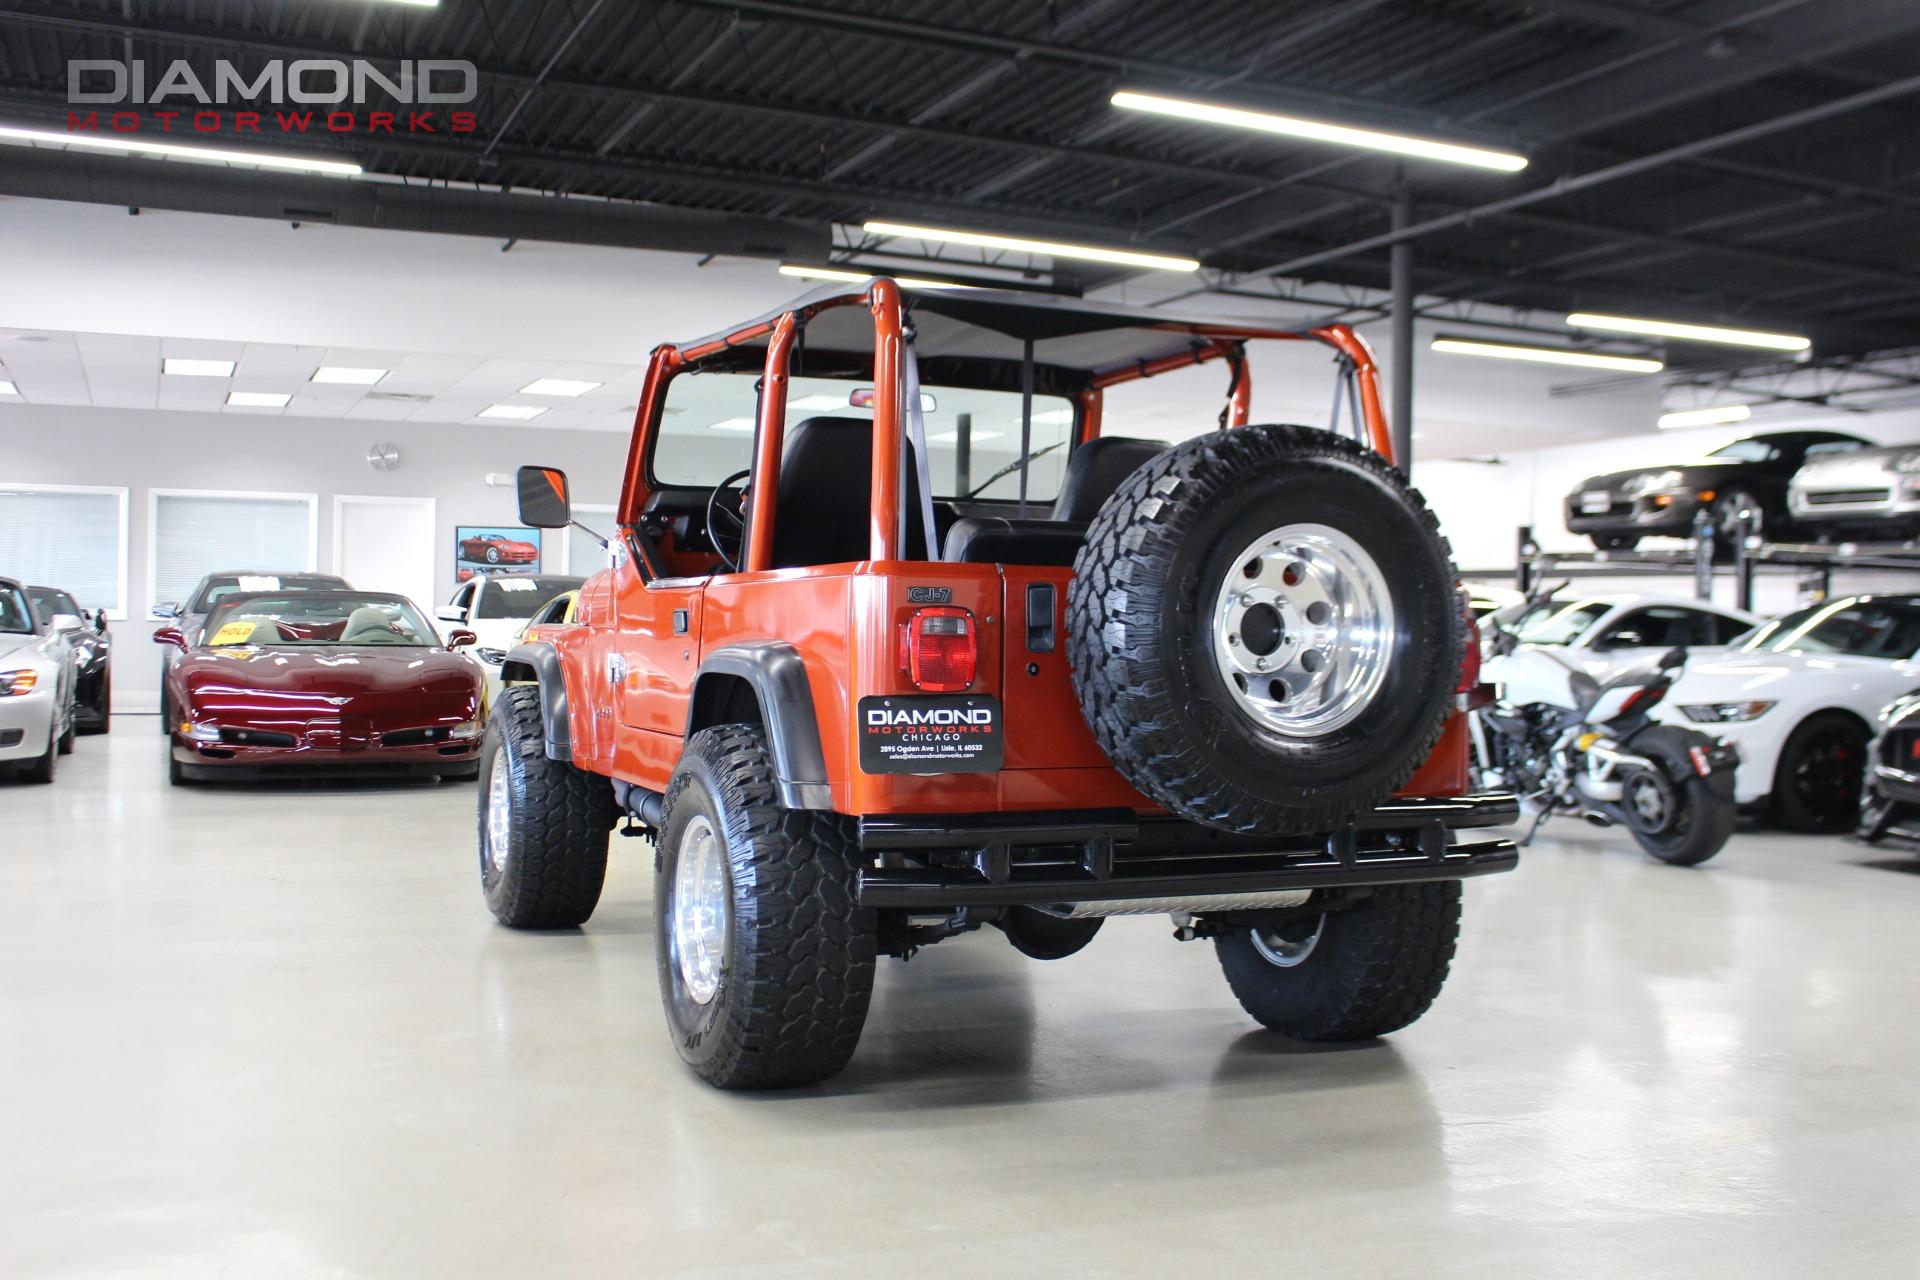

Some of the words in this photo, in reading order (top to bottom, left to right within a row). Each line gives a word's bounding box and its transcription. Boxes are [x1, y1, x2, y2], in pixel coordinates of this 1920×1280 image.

[220, 627, 251, 635] HOLD
[868, 709, 991, 725] DIAMOND
[868, 726, 992, 734] MOTORWORKS
[902, 733, 960, 742] CHICAGO
[880, 745, 896, 753] 2895
[896, 745, 920, 754] Ogden
